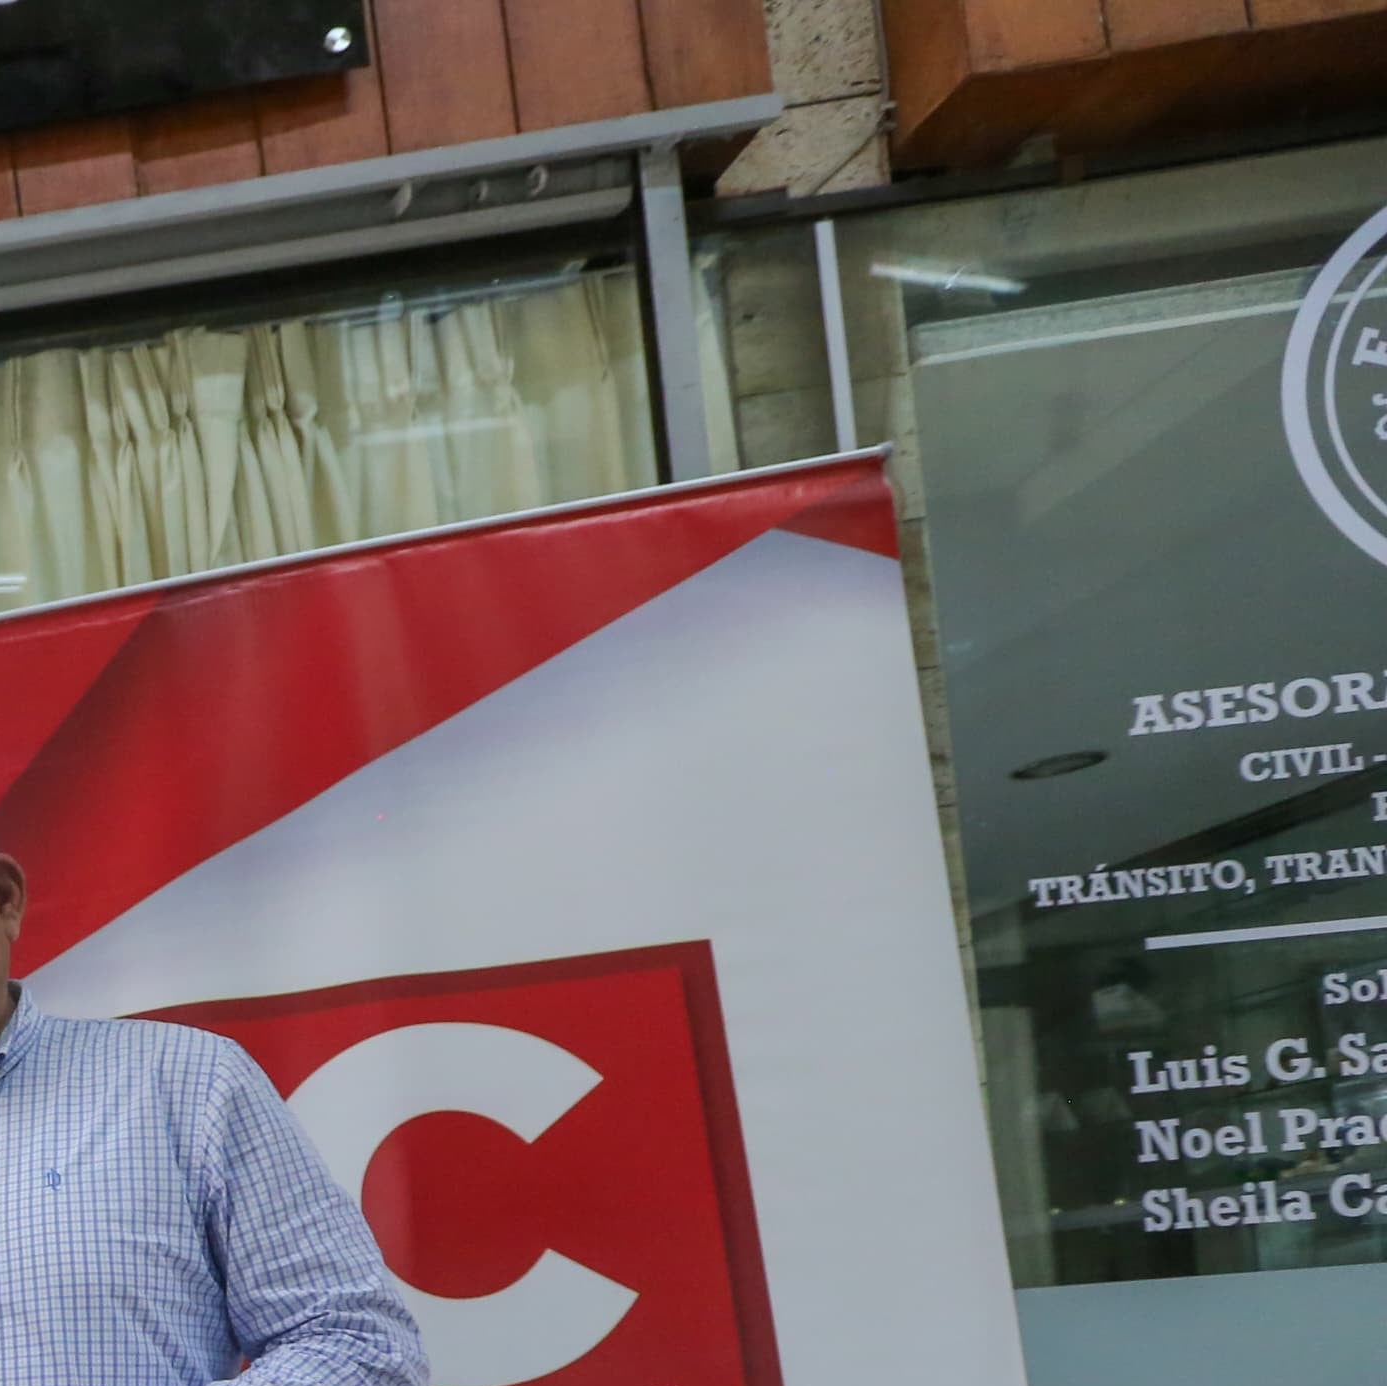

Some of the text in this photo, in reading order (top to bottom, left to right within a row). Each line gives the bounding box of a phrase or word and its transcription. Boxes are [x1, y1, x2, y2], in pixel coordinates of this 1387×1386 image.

[1130, 672, 1387, 736] ASESOR
[1240, 743, 1364, 784] CIVIL
[1029, 844, 1387, 908] TRÁNSITO, TRAN
[1130, 1045, 1250, 1094] Luis
[1266, 1038, 1326, 1083] G.
[1137, 1108, 1387, 1163] Noel Pra
[1142, 1183, 1317, 1232] Sheila
